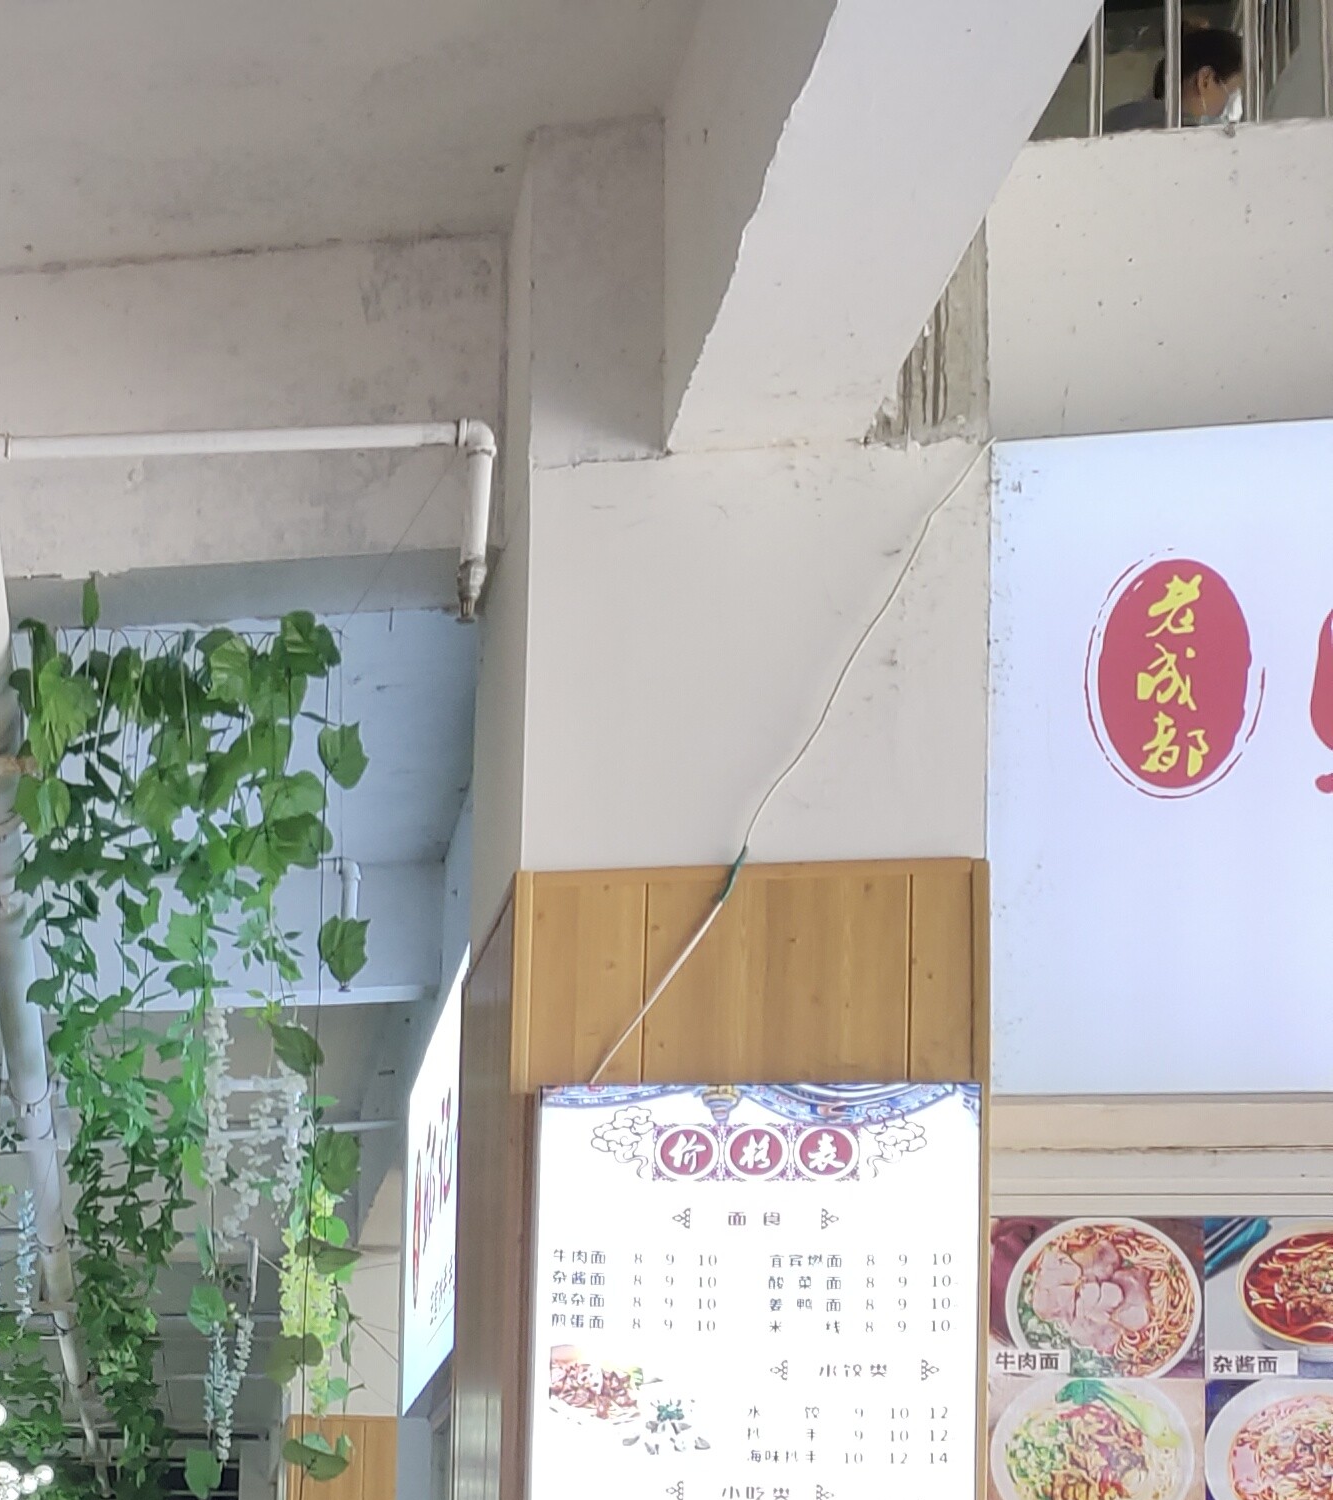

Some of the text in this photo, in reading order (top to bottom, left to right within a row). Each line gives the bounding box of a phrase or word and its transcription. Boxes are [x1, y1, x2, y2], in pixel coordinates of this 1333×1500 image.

[1137, 574, 1210, 777] 老成都
[668, 1132, 846, 1173] 价格表
[553, 1249, 717, 1266] 牛肉面 8 9 10
[867, 1254, 875, 1266] 8
[899, 1254, 907, 1266] 9
[933, 1253, 951, 1265] 10
[552, 1270, 716, 1288] 杂酱面 8 9 10
[866, 1277, 875, 1288] 8
[899, 1276, 907, 1288] 9
[933, 1275, 951, 1287] 10
[552, 1292, 716, 1310] 鸡杂面 8 9 10
[866, 1299, 874, 1310] 8
[898, 1299, 906, 1310] 9
[932, 1298, 950, 1309] 10
[633, 1318, 641, 1329] 8
[664, 1319, 673, 1330] 9
[698, 1320, 715, 1331] 10
[866, 1321, 873, 1332] 8
[898, 1321, 906, 1332] 9
[931, 1320, 950, 1332] 10
[995, 1353, 1059, 1371] 牛肉面
[1213, 1355, 1278, 1374] 杂酱面
[855, 1408, 863, 1417] 9
[891, 1408, 909, 1419] 10
[930, 1407, 948, 1419] 12
[855, 1431, 863, 1440] 9
[891, 1430, 909, 1442] 10
[930, 1430, 947, 1442] 12
[845, 1453, 862, 1463] 10
[890, 1453, 907, 1464] 12
[929, 1452, 947, 1464] 14
